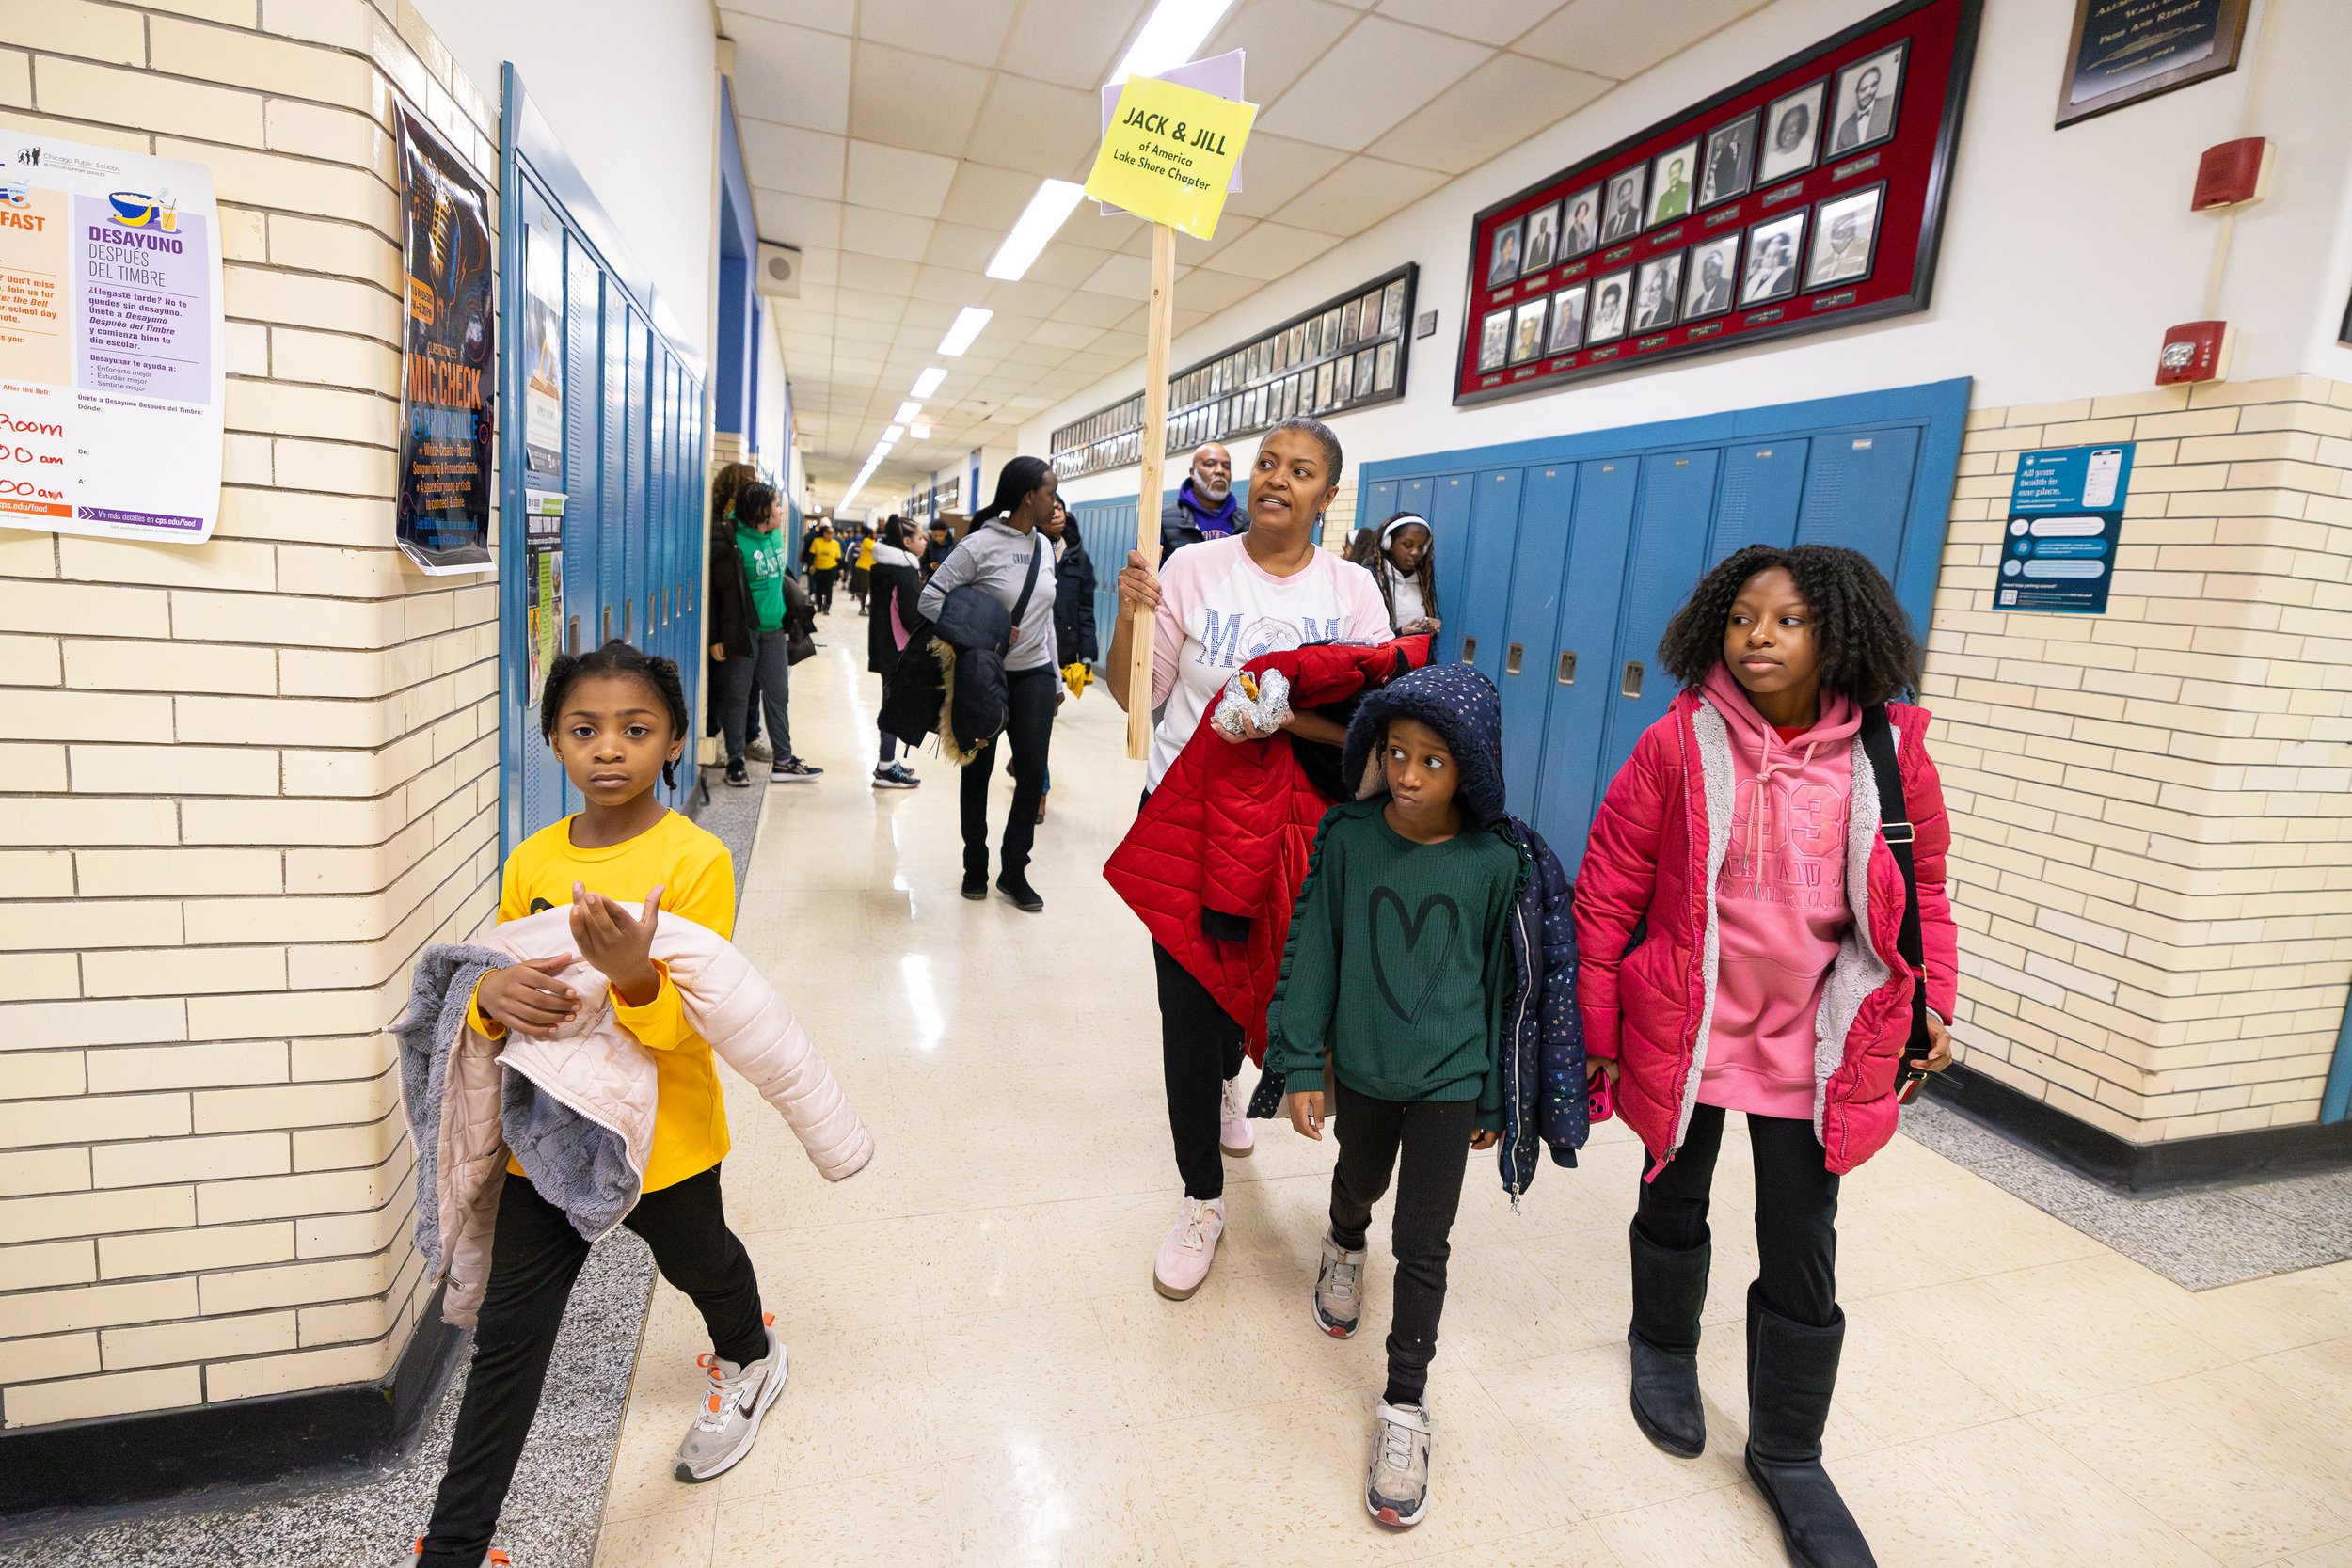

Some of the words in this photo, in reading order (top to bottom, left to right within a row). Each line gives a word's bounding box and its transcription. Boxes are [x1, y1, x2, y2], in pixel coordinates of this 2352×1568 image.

[1122, 107, 1170, 136] JACK
[1171, 121, 1186, 142] &
[1190, 128, 1226, 156] JILL
[43, 152, 73, 165] Chicago
[74, 158, 94, 167] Public
[96, 163, 120, 171] Schools
[1138, 141, 1152, 151] of
[1152, 145, 1193, 167] America
[1114, 149, 1136, 166] Lake
[1137, 157, 1166, 175] Shore
[1168, 167, 1211, 192] Chapter
[89, 226, 183, 254] DESAYUNO
[89, 244, 149, 267] DESPUÉS
[7, 275, 31, 286] Don't
[34, 279, 55, 289] miss
[89, 261, 113, 279] DEL
[118, 265, 166, 287] TIMBRE
[7, 285, 24, 294] Join
[41, 288, 55, 298] for
[88, 287, 131, 300] ¿Llegaste
[134, 293, 162, 304] tarde?
[13, 295, 28, 305] the
[30, 299, 48, 308] Bell
[88, 297, 120, 308] quedes
[139, 304, 183, 316] desayuno.
[8, 306, 38, 316] school
[40, 310, 56, 320] day
[89, 305, 114, 317] Únete
[125, 311, 167, 325] Desayuno
[89, 316, 127, 328] Después
[129, 323, 143, 331] del
[146, 325, 175, 335] Timbre
[97, 328, 138, 340] comienza
[141, 333, 159, 342] bien
[106, 339, 141, 350] escolar.
[90, 355, 131, 366] Desayunar
[143, 361, 167, 372] ayuda
[97, 365, 131, 374] Enfocarte
[132, 370, 152, 378] mejor
[97, 373, 125, 382] Estudiar
[408, 353, 436, 404] MIC
[439, 360, 482, 410] CHECK
[3, 384, 20, 392] After
[22, 386, 34, 394] the
[35, 388, 51, 396] Bell:
[97, 381, 124, 389] Sentirte
[125, 384, 146, 392] mejor
[77, 393, 97, 402] Únete
[105, 397, 136, 407] Desayuno
[138, 402, 166, 411] Después
[179, 406, 204, 416] Timbre:
[78, 404, 103, 412] Dónde:
[411, 406, 422, 440] @
[40, 455, 63, 465] am
[2035, 488, 2061, 497] place.
[98, 510, 106, 518] Ve
[107, 511, 121, 520] más
[122, 513, 146, 522] detalles
[155, 516, 197, 528] cps.edu/food
[1778, 858, 1821, 887] AND
